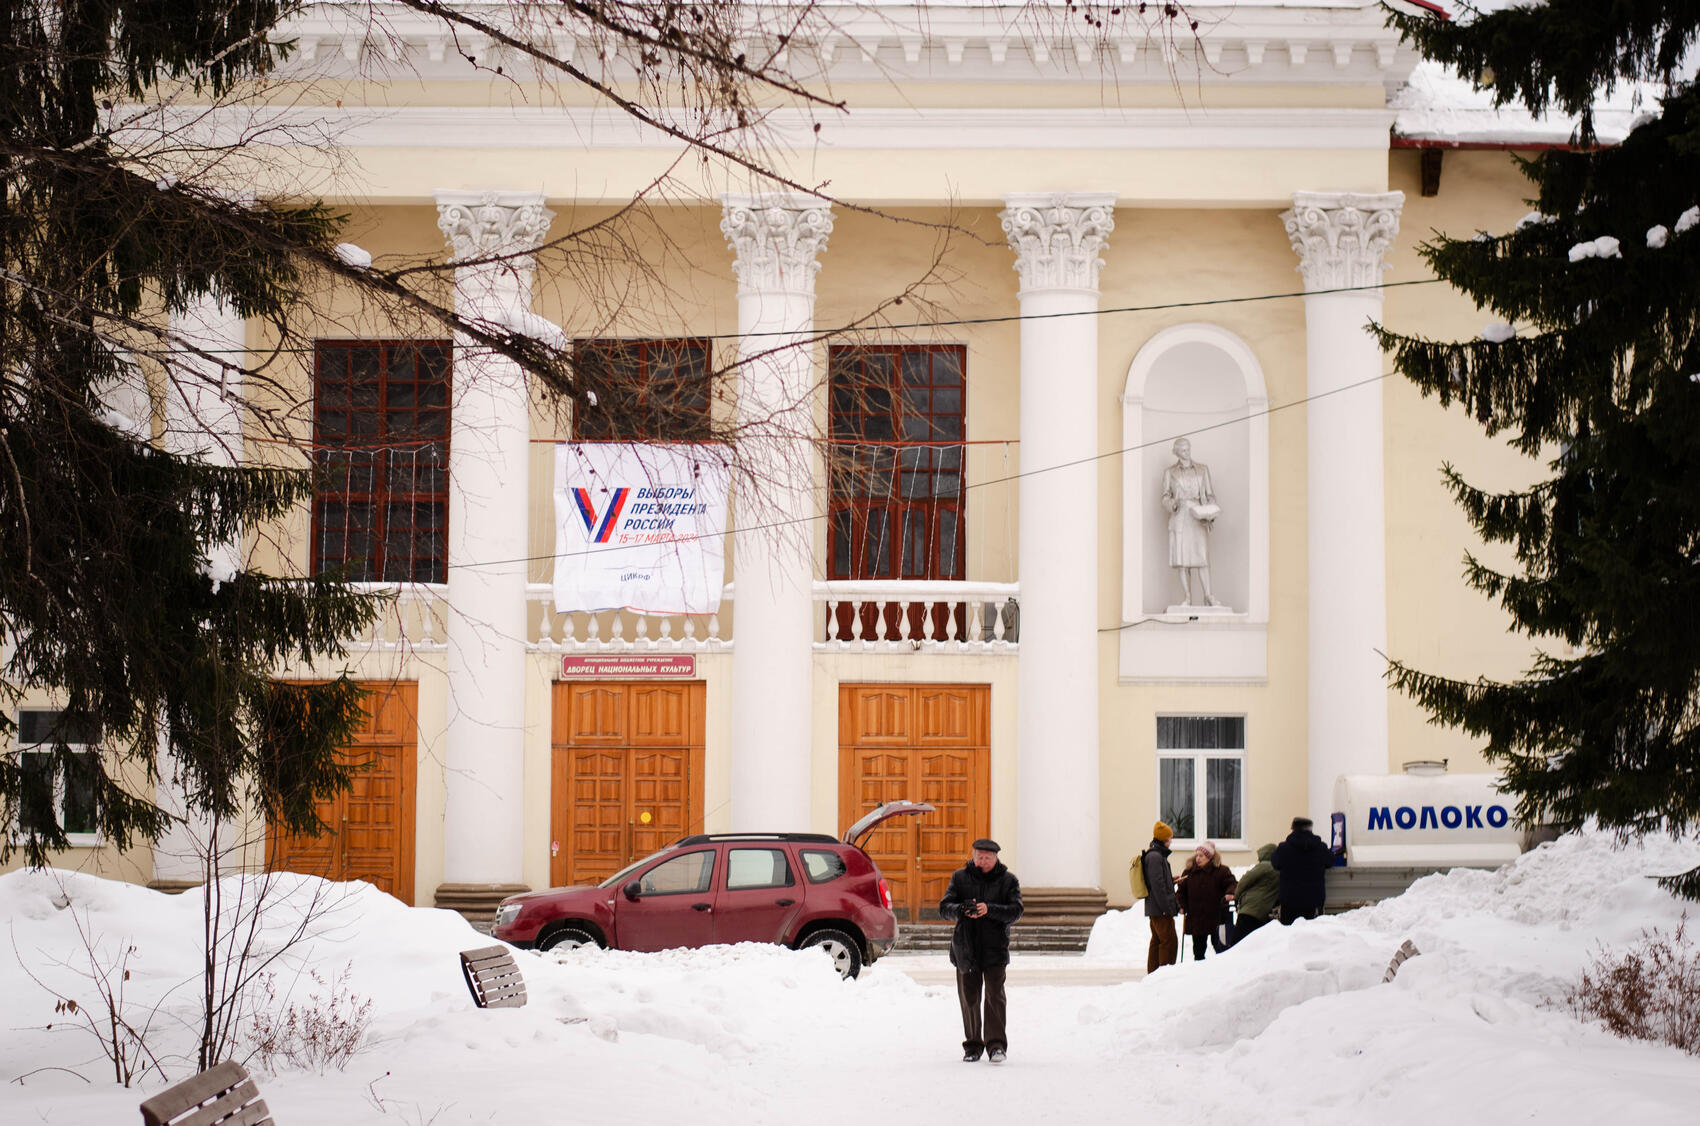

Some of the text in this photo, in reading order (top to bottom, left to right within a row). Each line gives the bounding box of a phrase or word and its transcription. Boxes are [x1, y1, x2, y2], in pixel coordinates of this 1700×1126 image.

[637, 487, 695, 499] ВЫБОРЫ
[630, 503, 707, 516] ПРЕЗИДЕНТА
[623, 519, 675, 530] РОССИИ
[645, 533, 675, 544] МАРТА
[660, 665, 691, 673] КУЛЬТУР
[1367, 805, 1508, 830] МОЛОКО
